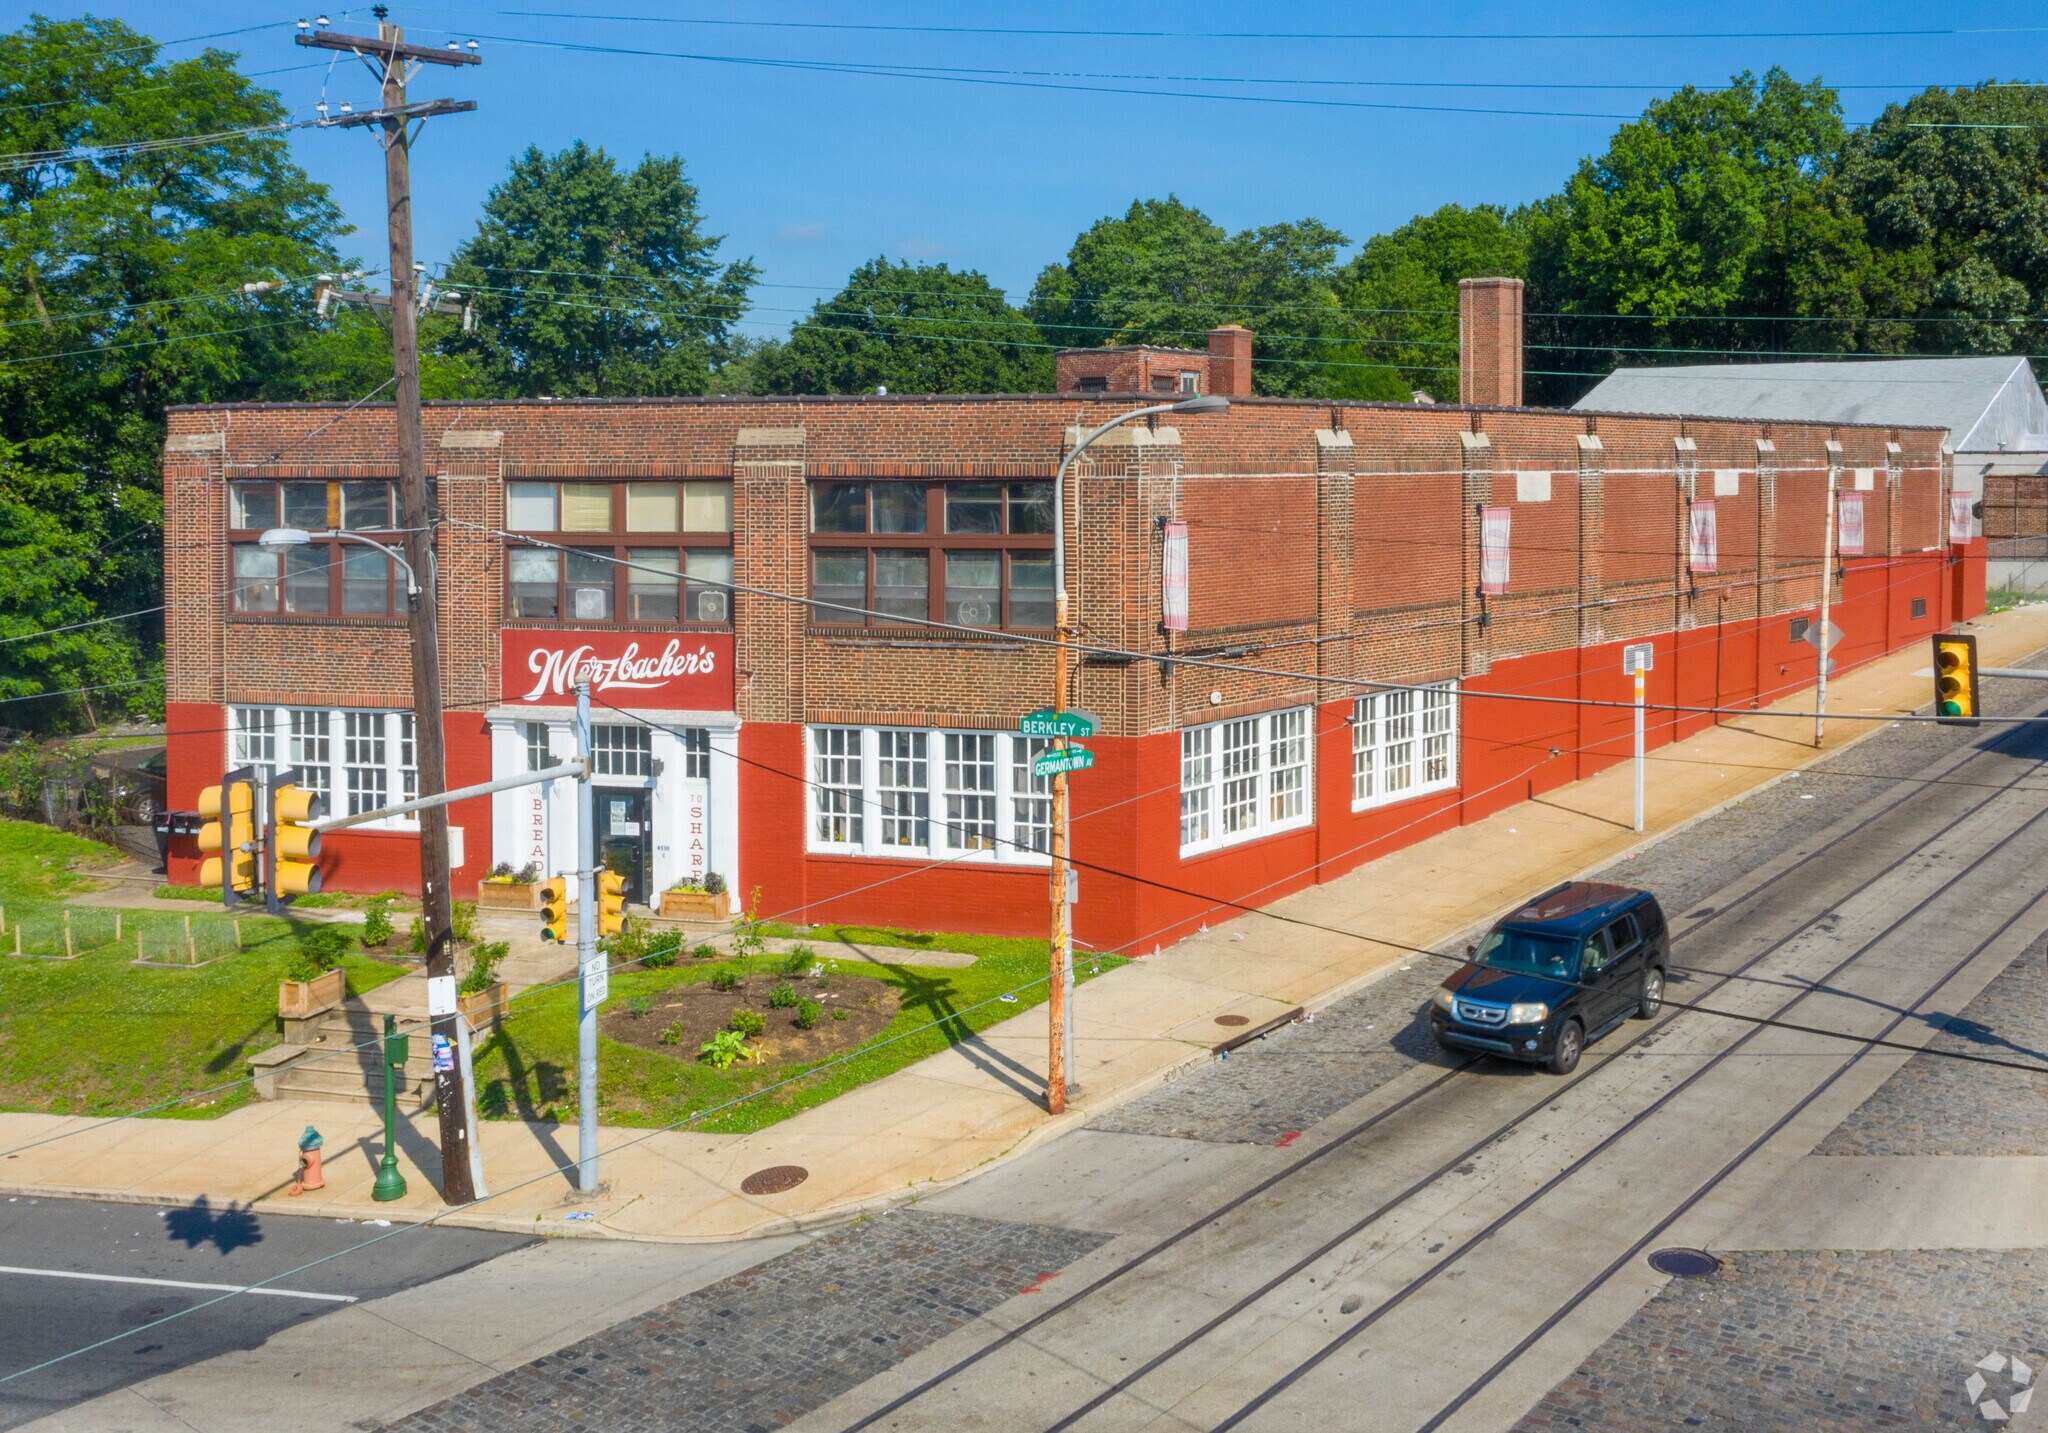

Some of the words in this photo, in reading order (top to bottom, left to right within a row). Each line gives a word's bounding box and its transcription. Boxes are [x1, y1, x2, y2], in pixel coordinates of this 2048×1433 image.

[522, 638, 714, 701] Merzbacher's
[1023, 720, 1076, 736] BERKLEY
[1080, 727, 1091, 737] ST
[1035, 756, 1085, 776] GERMANTOWN
[1086, 758, 1093, 766] AV
[690, 794, 703, 803] TO
[531, 799, 544, 872] BREAD
[689, 807, 704, 884] SHARE
[592, 960, 600, 972] NO
[589, 974, 605, 986] TURN
[587, 992, 595, 1003] ON
[596, 985, 605, 997] RED
